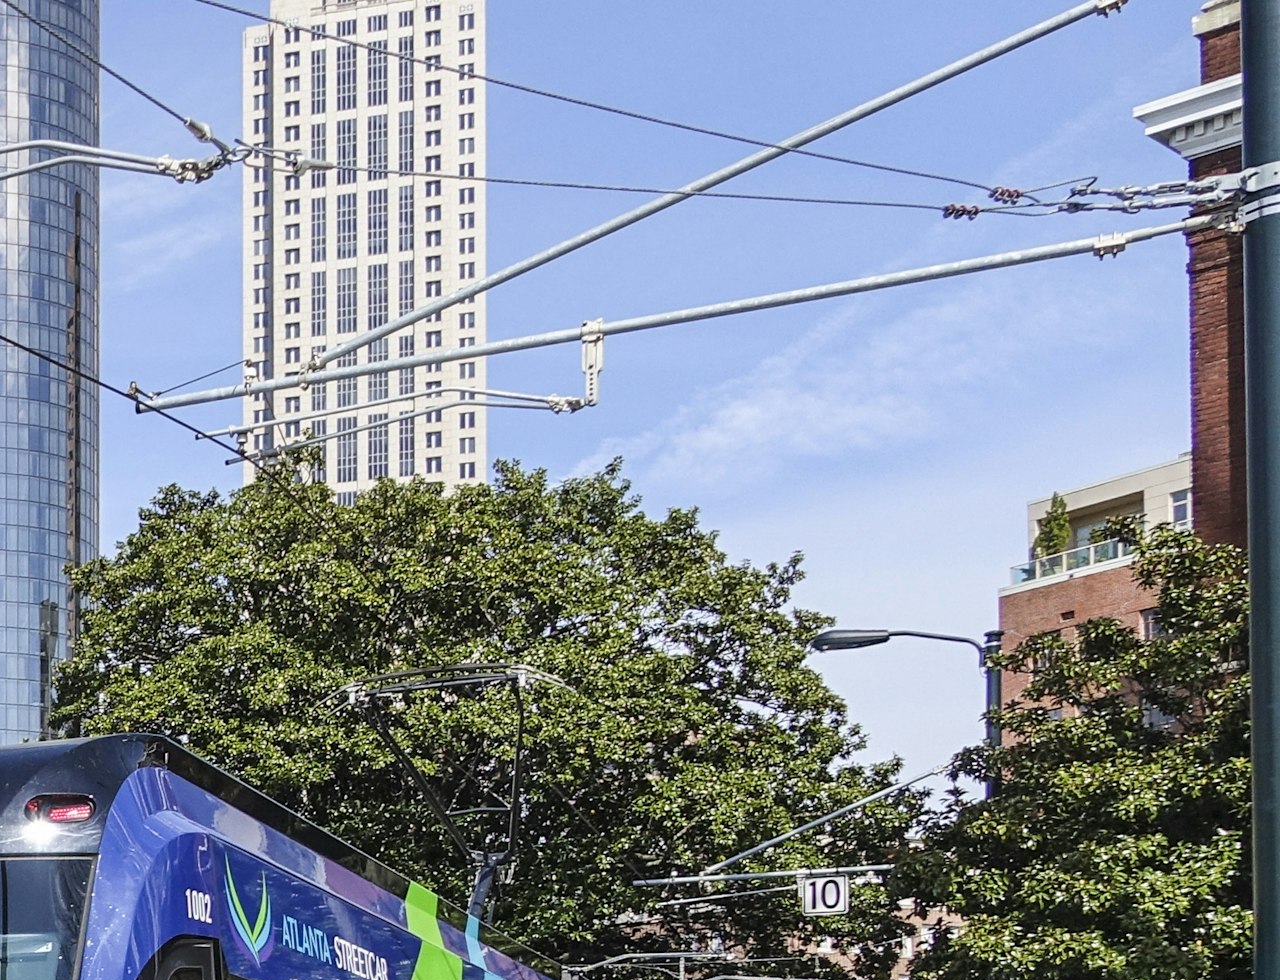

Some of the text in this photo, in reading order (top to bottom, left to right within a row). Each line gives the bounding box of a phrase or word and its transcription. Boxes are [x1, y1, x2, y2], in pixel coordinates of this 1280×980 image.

[185, 889, 213, 924] 1002
[809, 880, 840, 910] 10
[282, 914, 332, 965] ATLANTA
